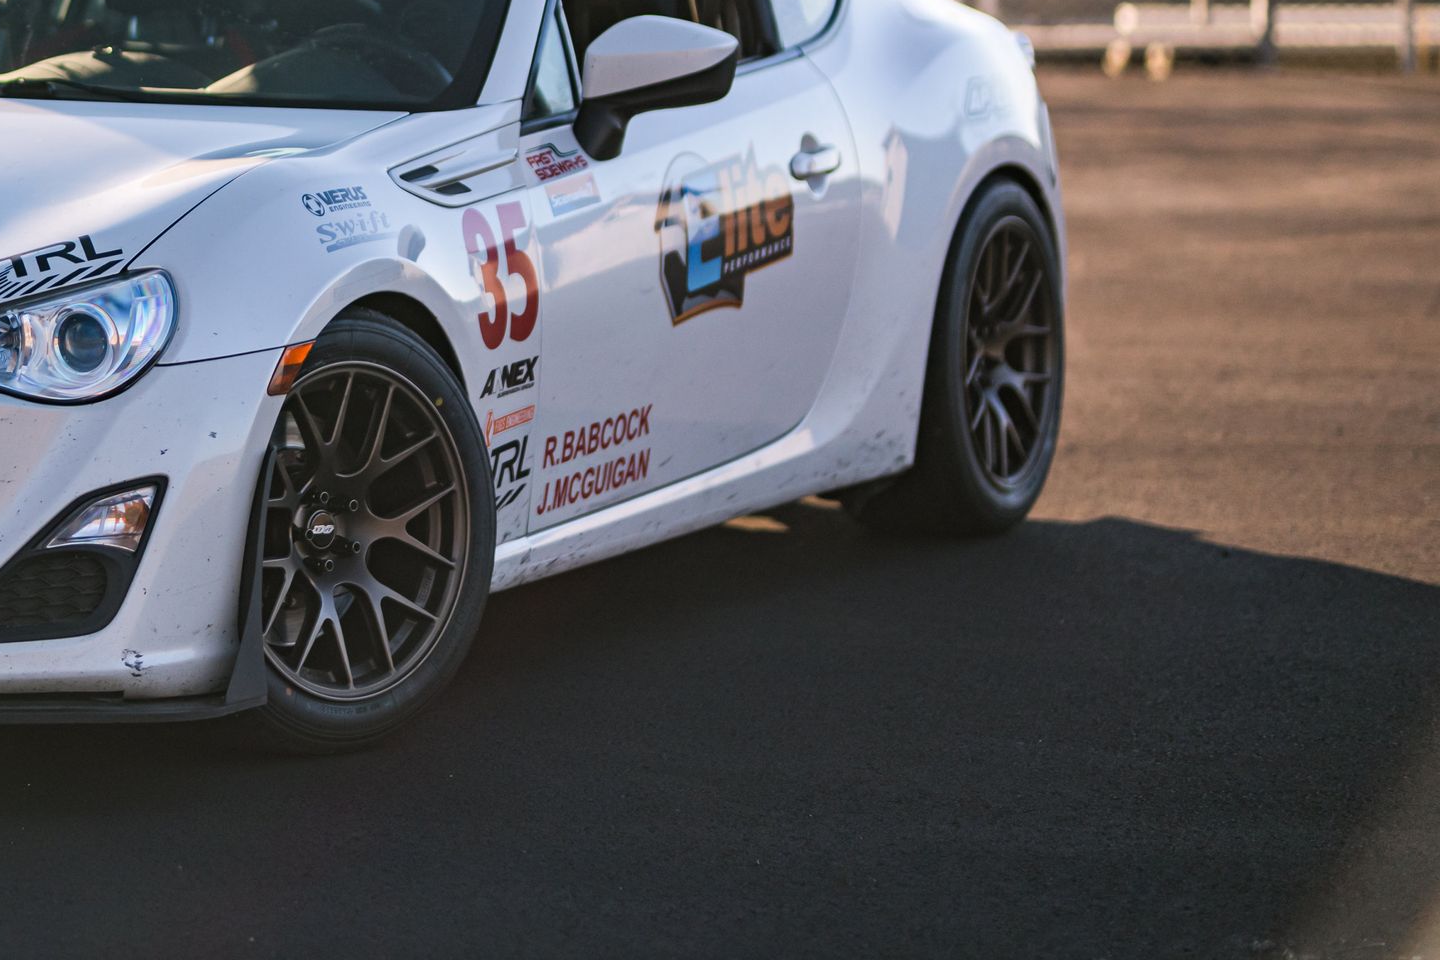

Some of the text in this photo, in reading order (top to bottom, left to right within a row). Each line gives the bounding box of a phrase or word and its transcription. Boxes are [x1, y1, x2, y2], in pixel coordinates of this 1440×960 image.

[317, 186, 367, 205] VERUS
[684, 145, 792, 293] Elite
[462, 200, 539, 350] 35
[724, 237, 791, 273] PERFORMANCE
[491, 435, 531, 489] TRL
[543, 404, 653, 469] R.BABCOCK
[537, 448, 651, 515] J.MCGUIGAN
